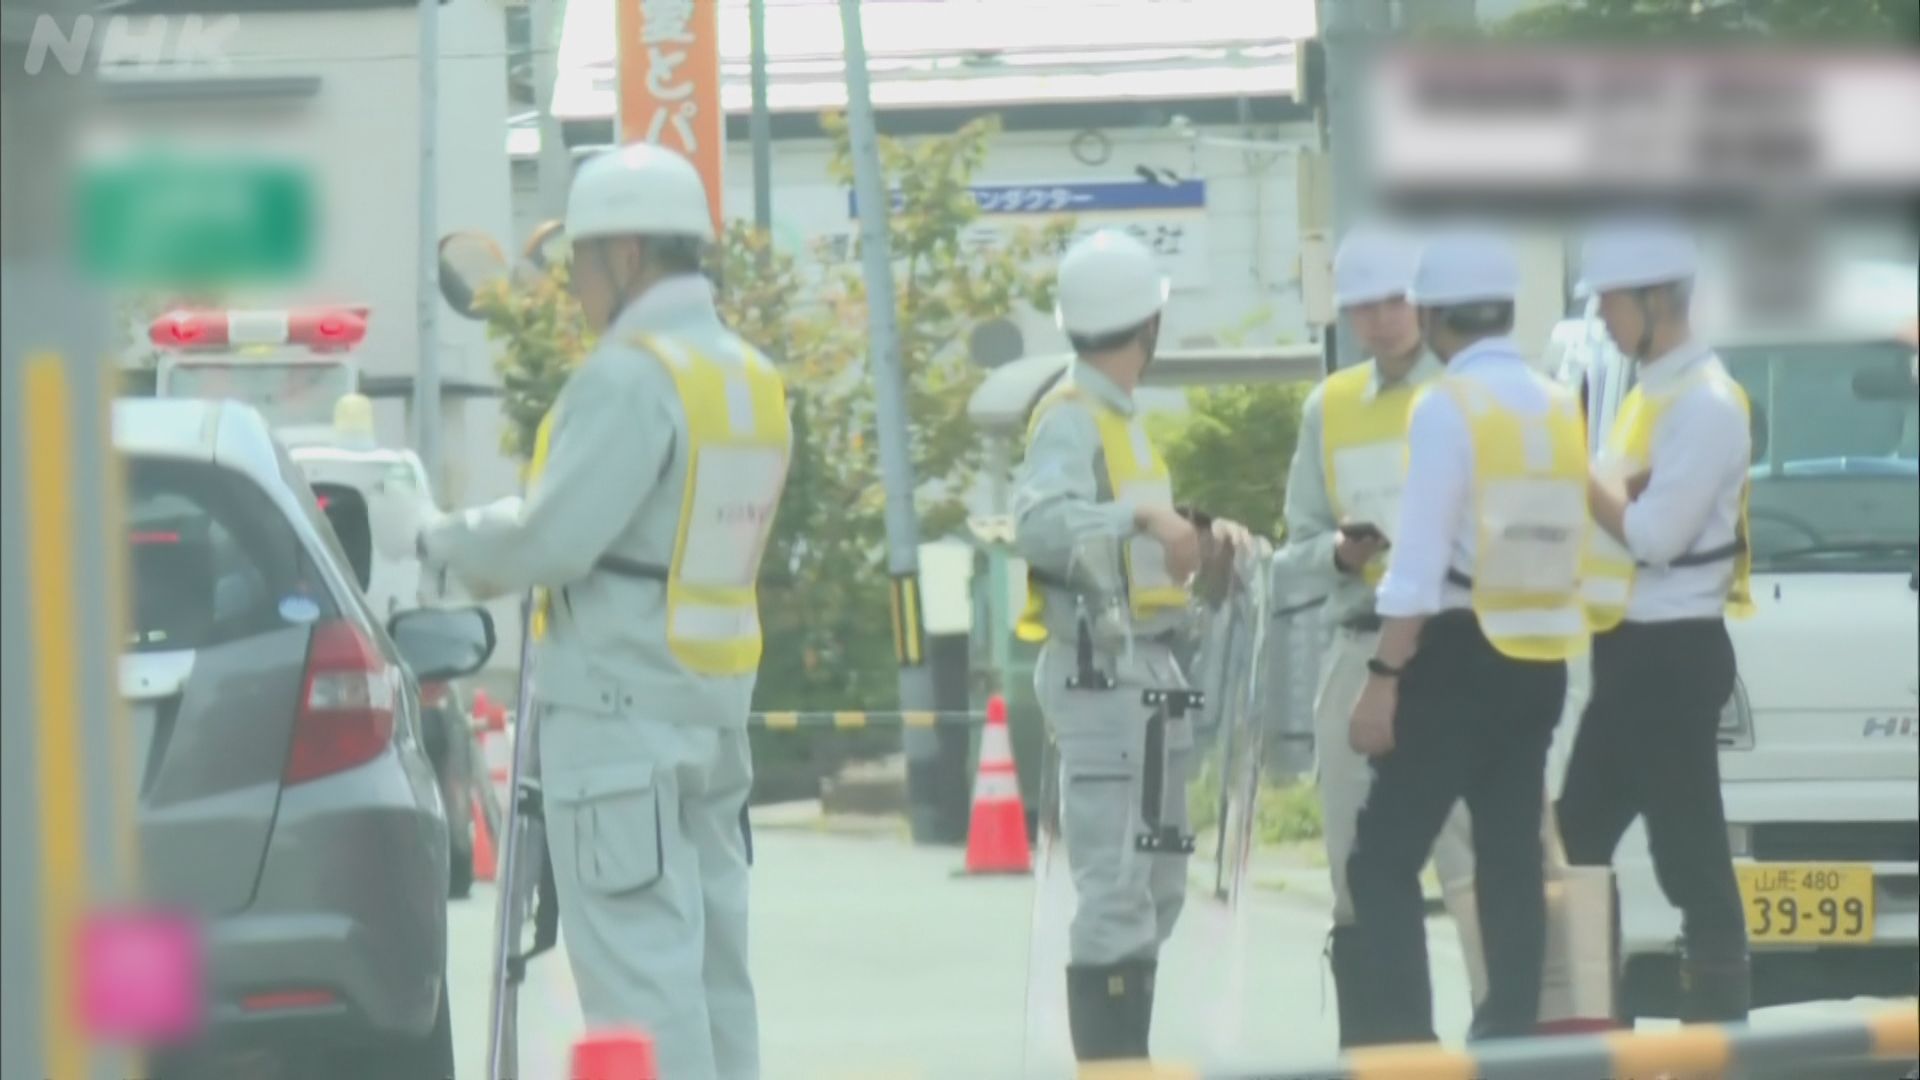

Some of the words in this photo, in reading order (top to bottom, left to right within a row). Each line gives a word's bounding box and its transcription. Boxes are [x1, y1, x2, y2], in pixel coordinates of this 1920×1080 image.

[967, 187, 1095, 212] ンダクター
[1862, 717, 1917, 737] HI
[1754, 869, 1798, 892] 山形
[1801, 870, 1839, 891] 480
[1752, 897, 1863, 936] 39-99
